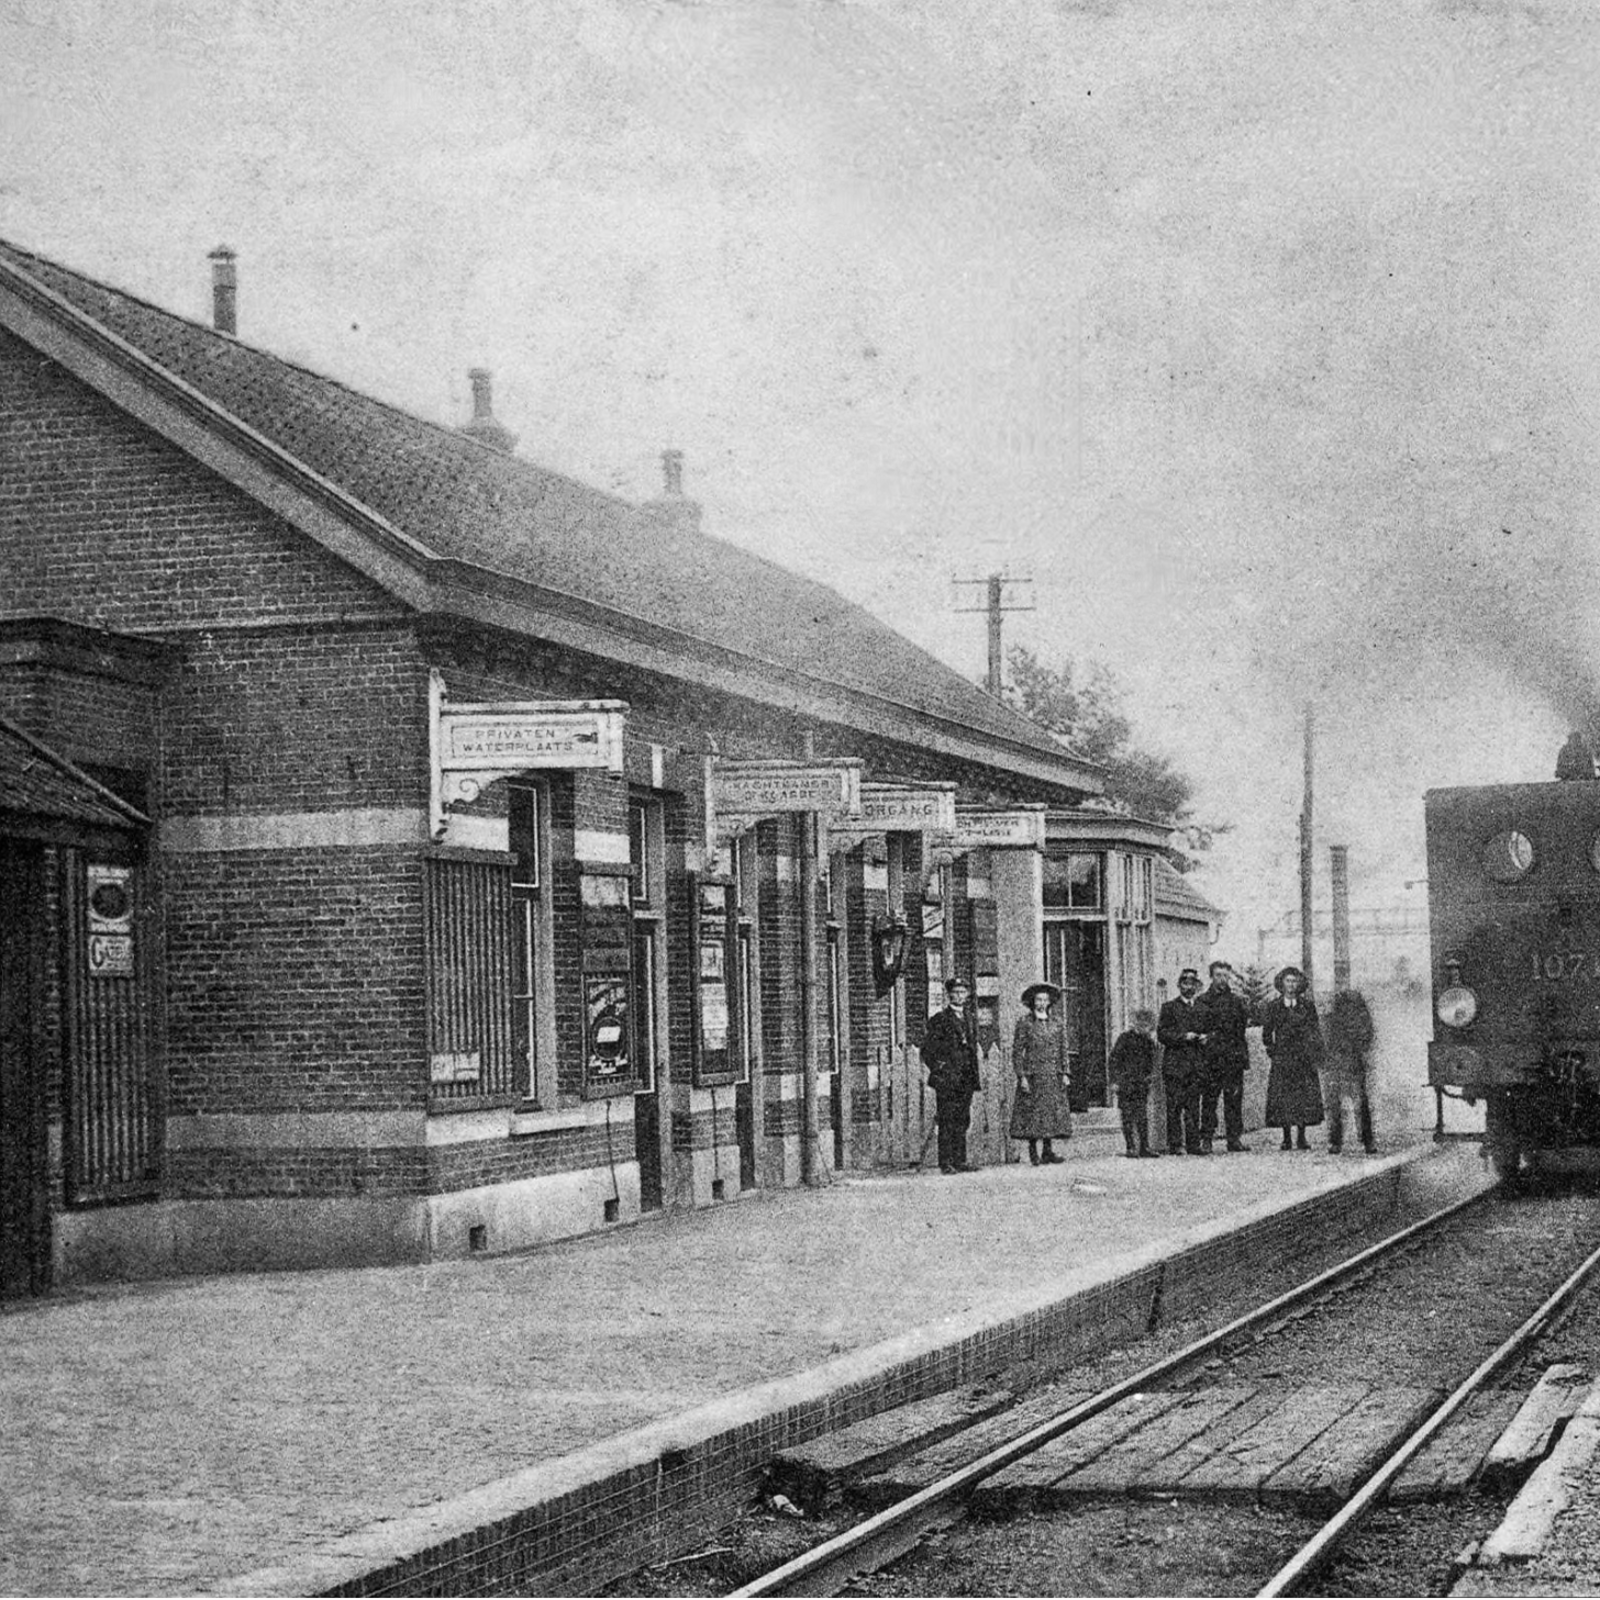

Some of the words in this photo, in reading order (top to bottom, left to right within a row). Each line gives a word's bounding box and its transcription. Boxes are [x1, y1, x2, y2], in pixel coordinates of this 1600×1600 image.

[474, 729, 555, 739] PRIVATEN
[462, 741, 574, 752] WATERPLAATS
[841, 804, 933, 817] ORGANG
